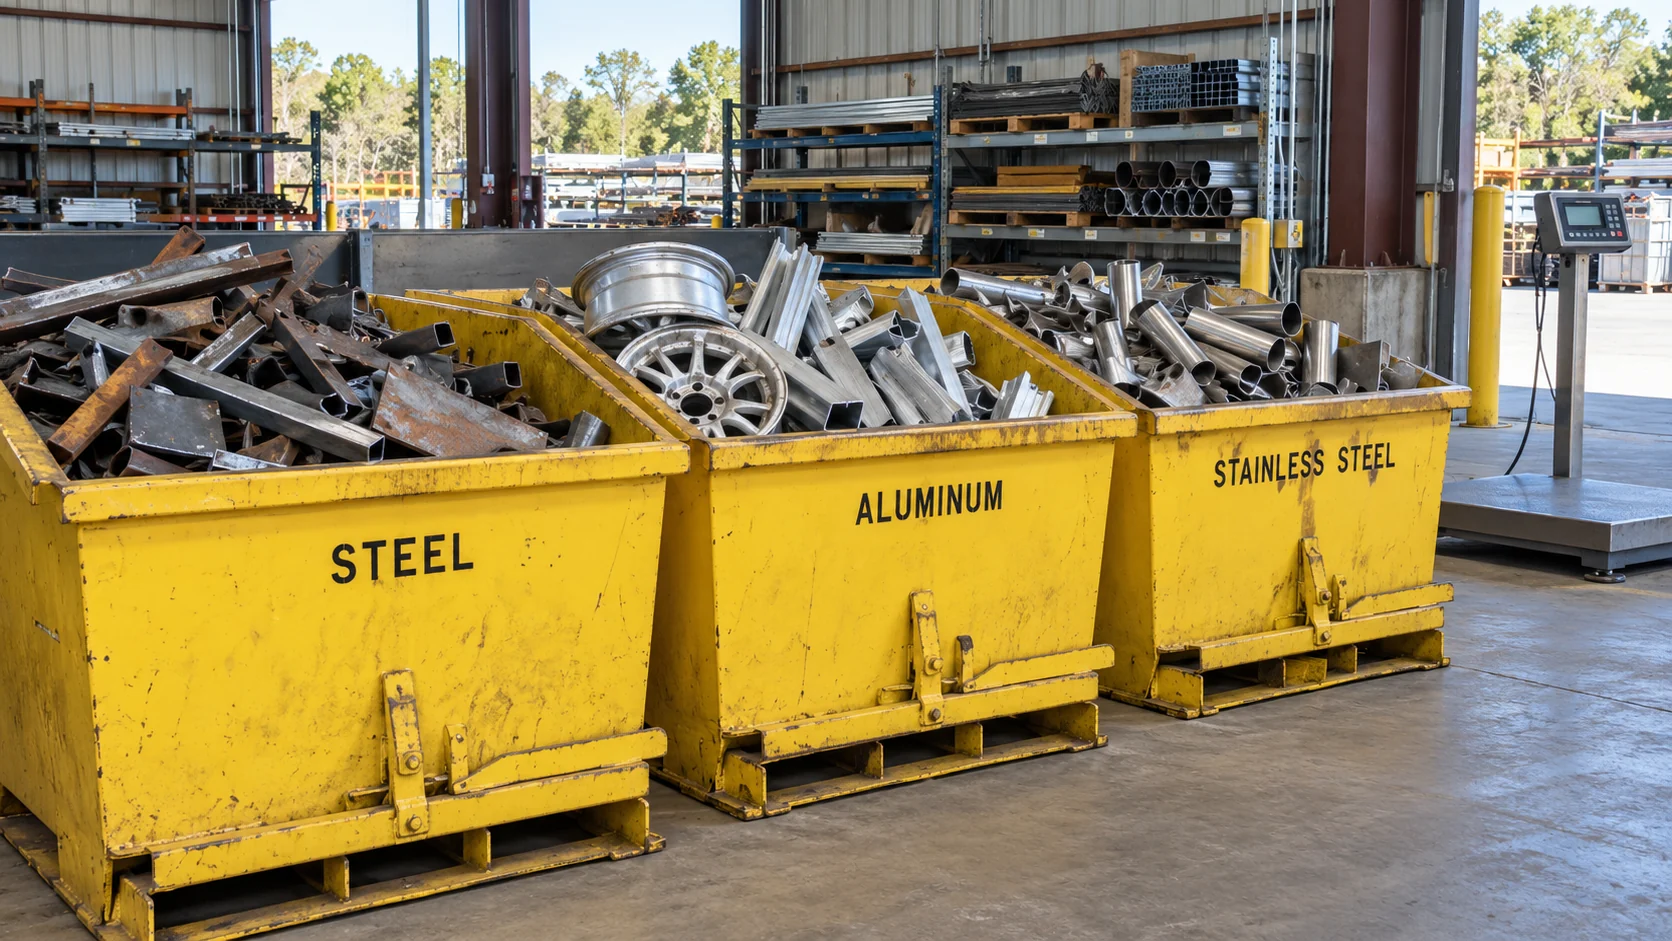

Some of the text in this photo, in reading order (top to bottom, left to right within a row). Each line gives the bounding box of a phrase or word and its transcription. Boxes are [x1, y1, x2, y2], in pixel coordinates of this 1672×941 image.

[1213, 442, 1396, 488] STAINLESS STEEL
[855, 479, 1004, 526] ALUMINUM
[331, 532, 475, 585] STEEL
